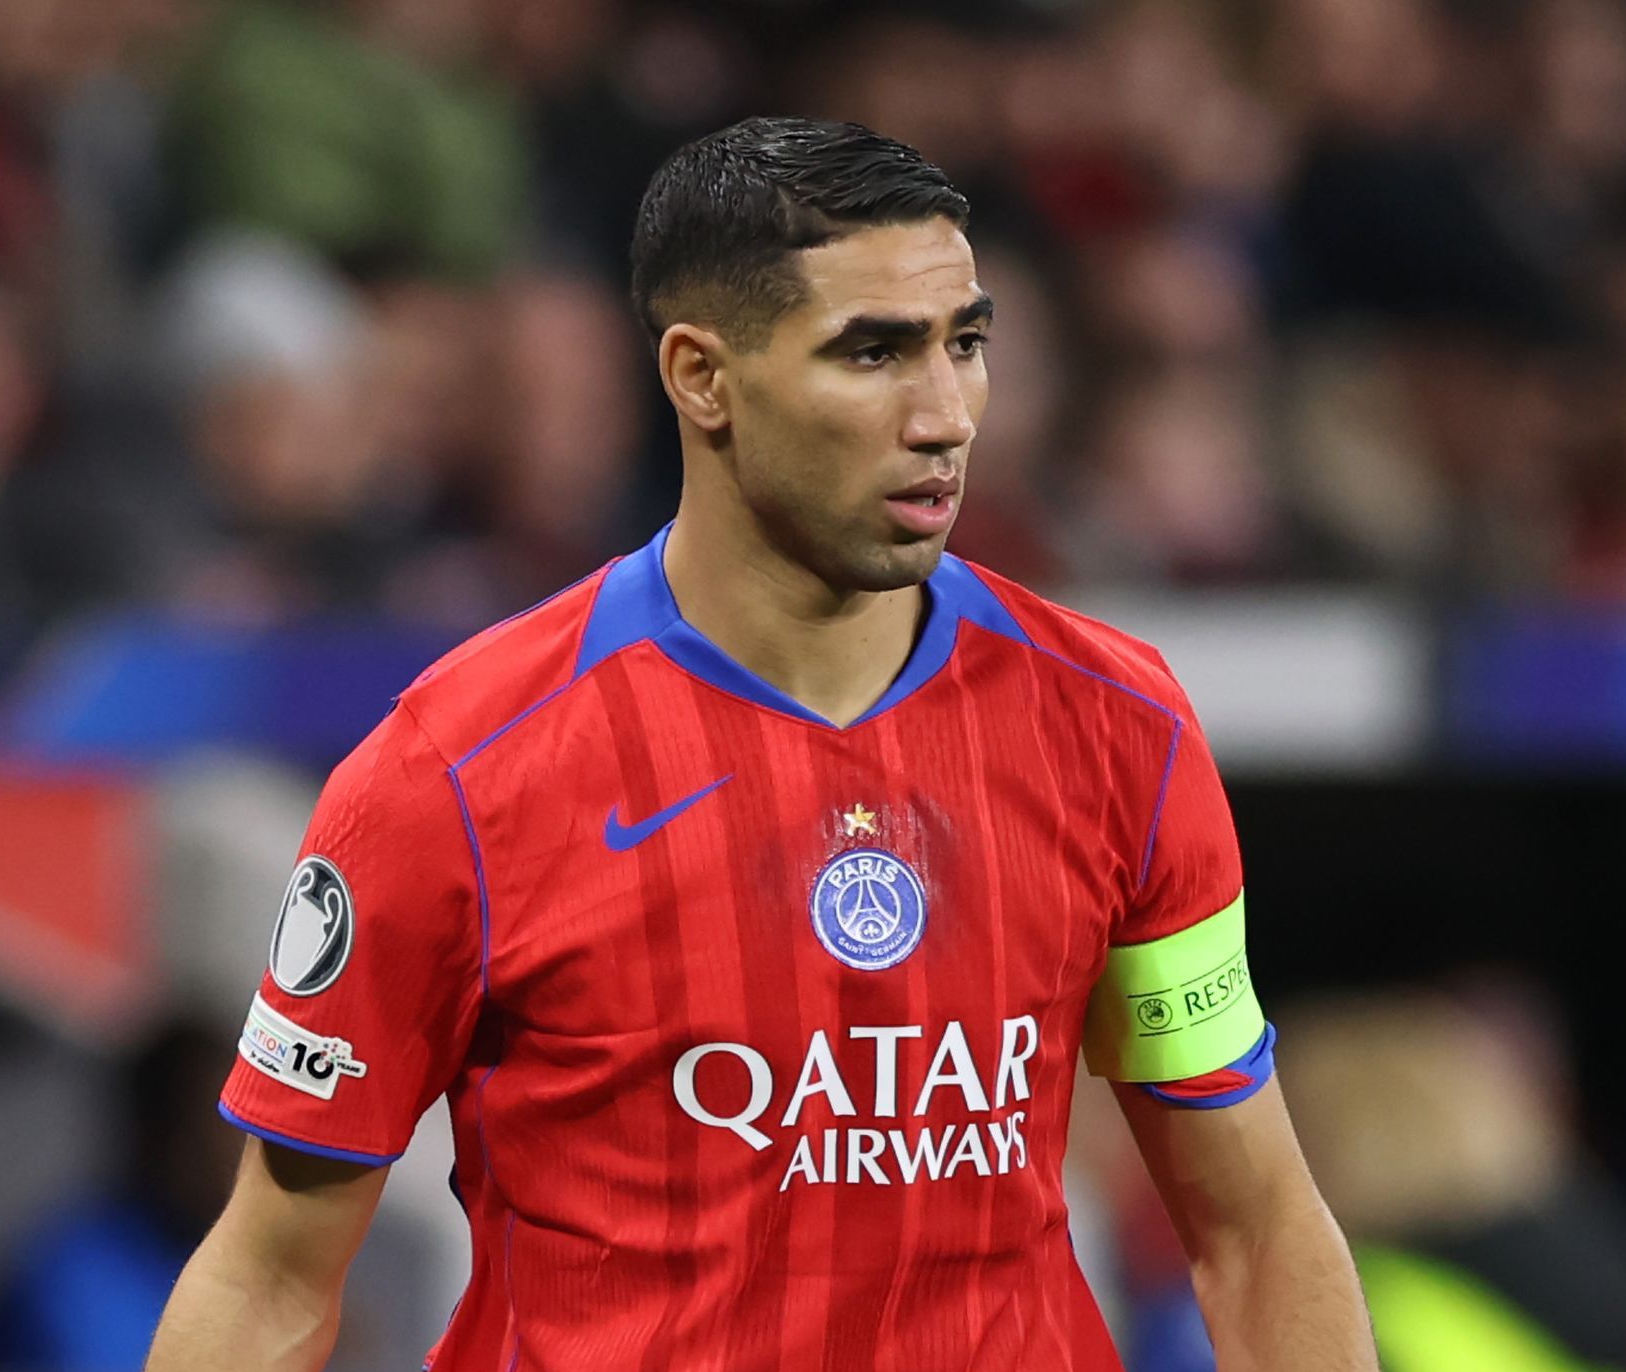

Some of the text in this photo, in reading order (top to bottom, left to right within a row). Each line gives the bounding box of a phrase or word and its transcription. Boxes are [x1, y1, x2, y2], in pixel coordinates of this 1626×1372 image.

[828, 858, 899, 889] PARIS
[292, 1042, 334, 1079] 10
[672, 1014, 1039, 1152] QATAR
[779, 1111, 1026, 1193] AIRWAYS
